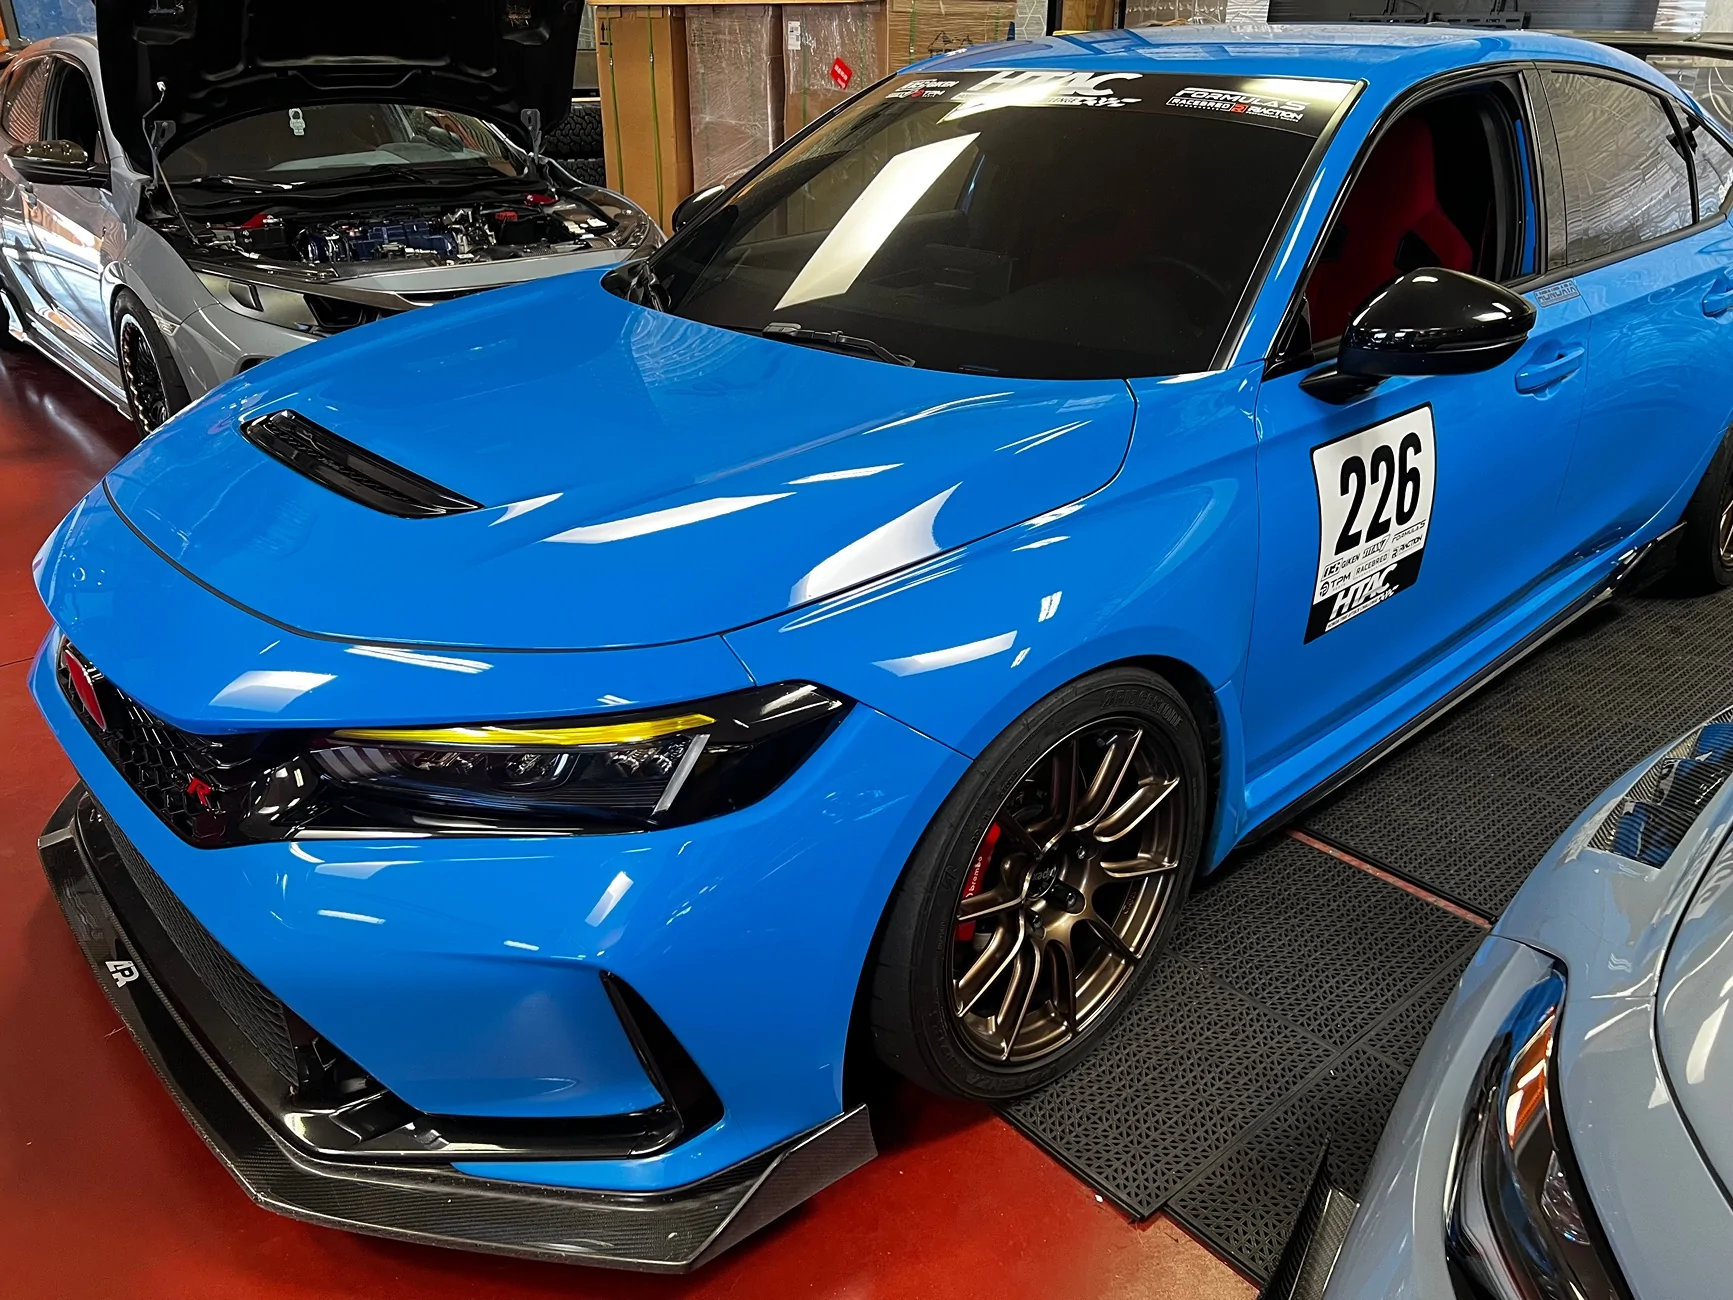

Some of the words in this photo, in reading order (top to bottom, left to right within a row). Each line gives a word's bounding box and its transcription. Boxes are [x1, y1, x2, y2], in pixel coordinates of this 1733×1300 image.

[967, 71, 1143, 96] HTAC
[1171, 98, 1231, 109] RACEBRED
[1175, 87, 1280, 108] FORMULA
[1279, 98, 1311, 111] S
[1334, 432, 1421, 556] 226
[1329, 563, 1398, 620] HTAC
[1331, 572, 1351, 588] TPM
